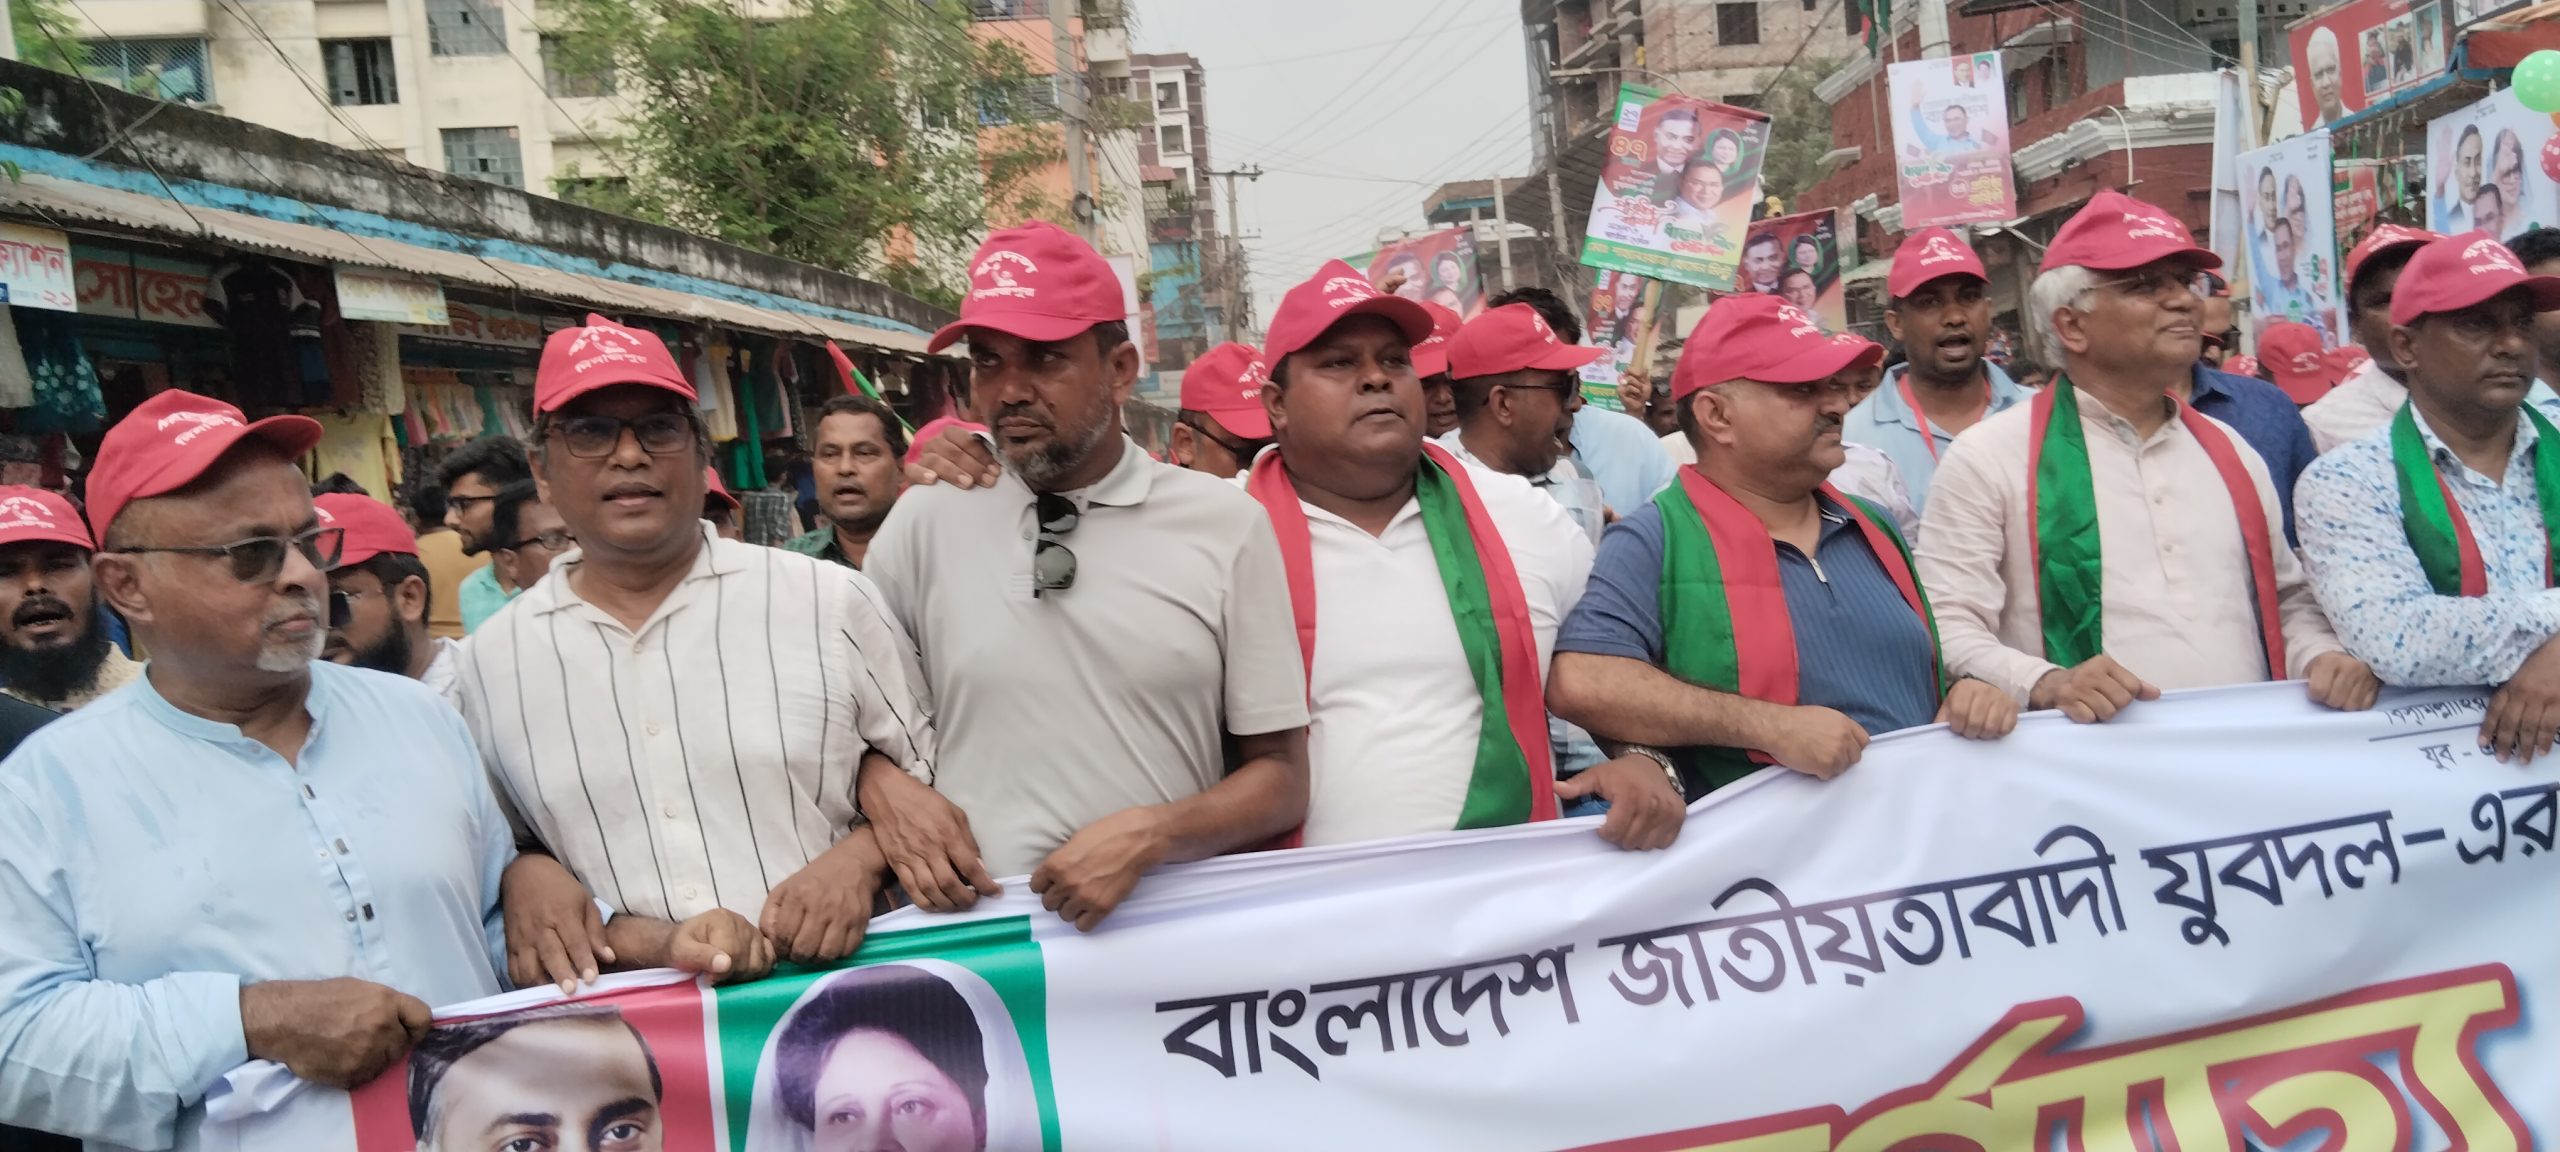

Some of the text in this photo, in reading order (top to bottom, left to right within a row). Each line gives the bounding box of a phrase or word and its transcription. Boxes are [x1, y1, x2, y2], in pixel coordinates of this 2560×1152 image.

[2418, 743, 2458, 772] যুব
[1155, 943, 1580, 1081] বাংলাদেশ
[1598, 825, 2127, 1009] জাতীয়তাবাদী
